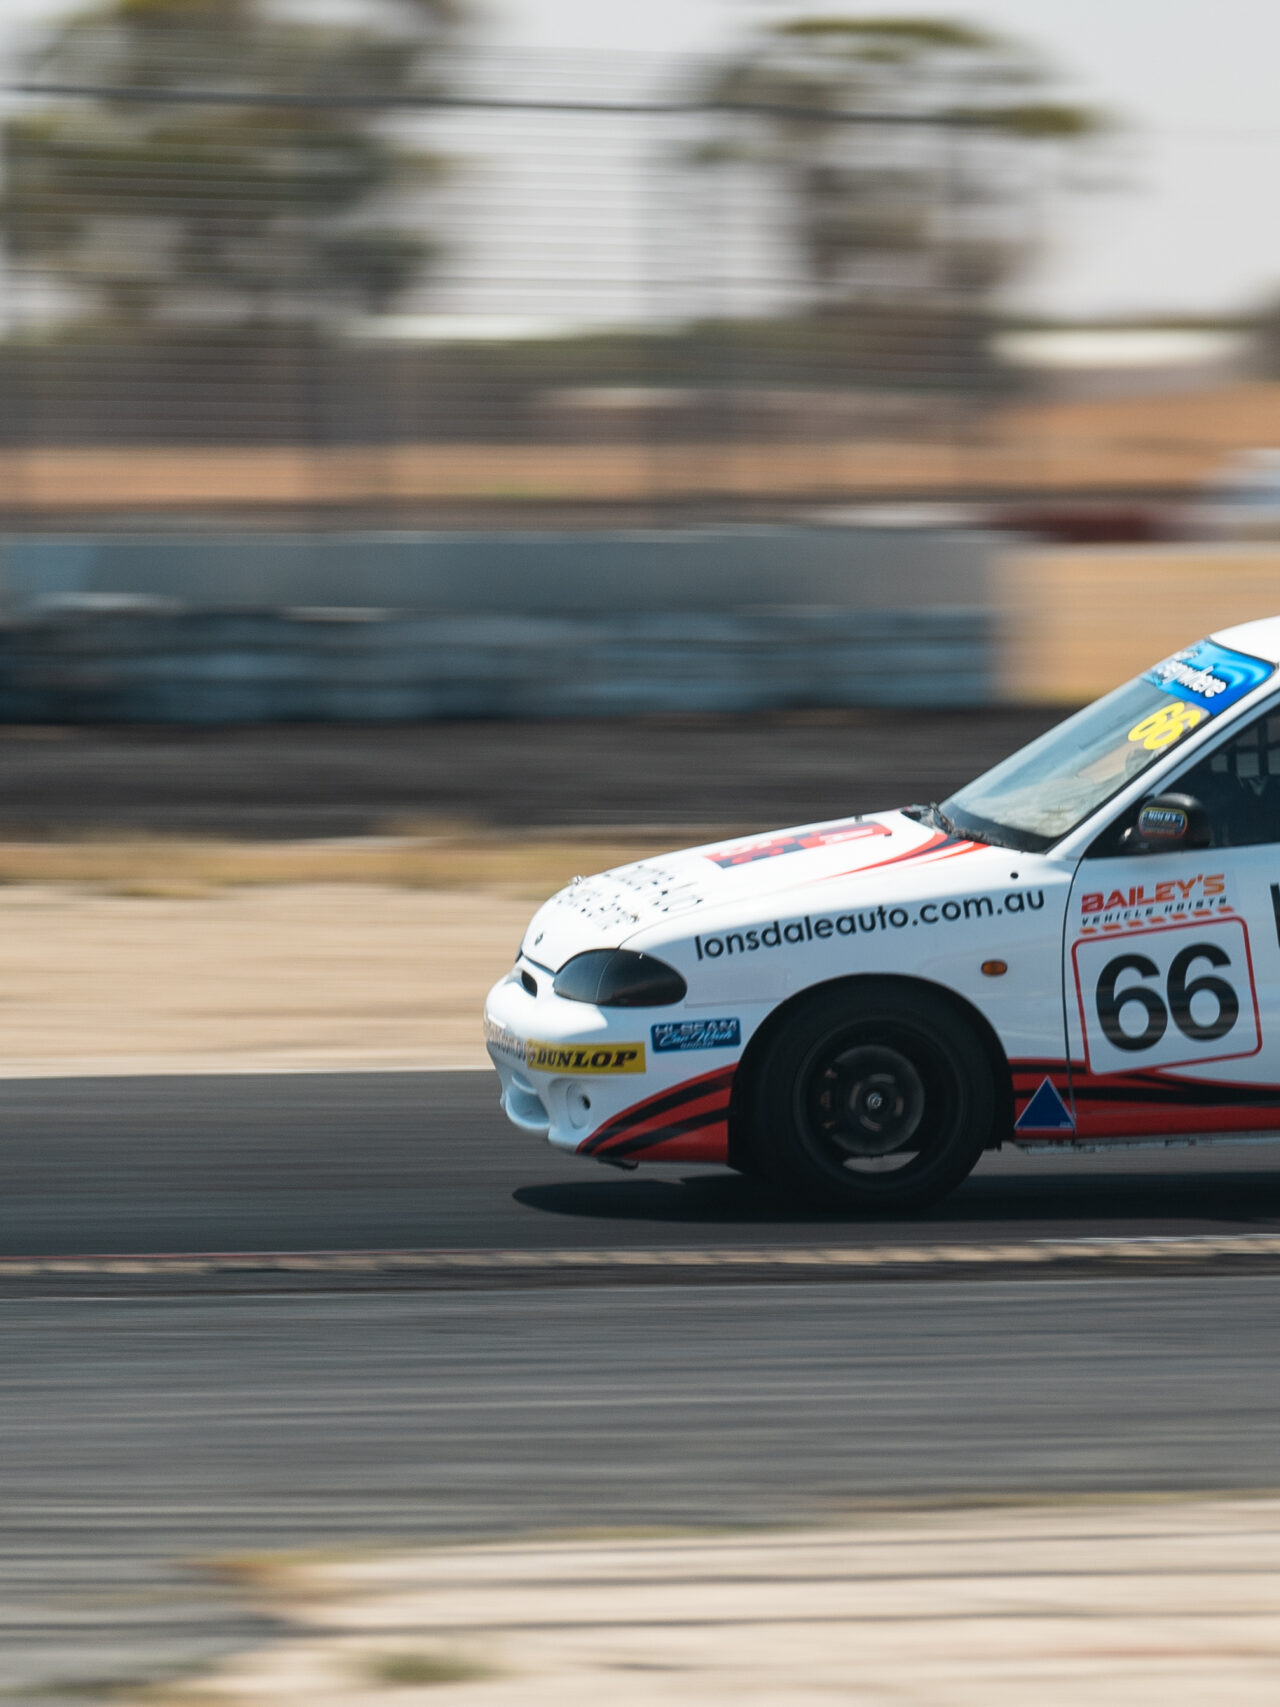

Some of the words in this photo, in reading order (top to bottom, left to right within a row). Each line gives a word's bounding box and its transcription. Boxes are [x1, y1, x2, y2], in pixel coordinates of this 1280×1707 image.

[1128, 701, 1201, 750] 66
[1081, 873, 1225, 915] BAILEY'S
[1081, 908, 1154, 926] VEHICLE
[1164, 896, 1228, 914] HOISTS
[694, 888, 1046, 961] lonsdaleauto.com.au
[1095, 942, 1240, 1052] 66
[537, 1049, 638, 1069] DUNLOP
